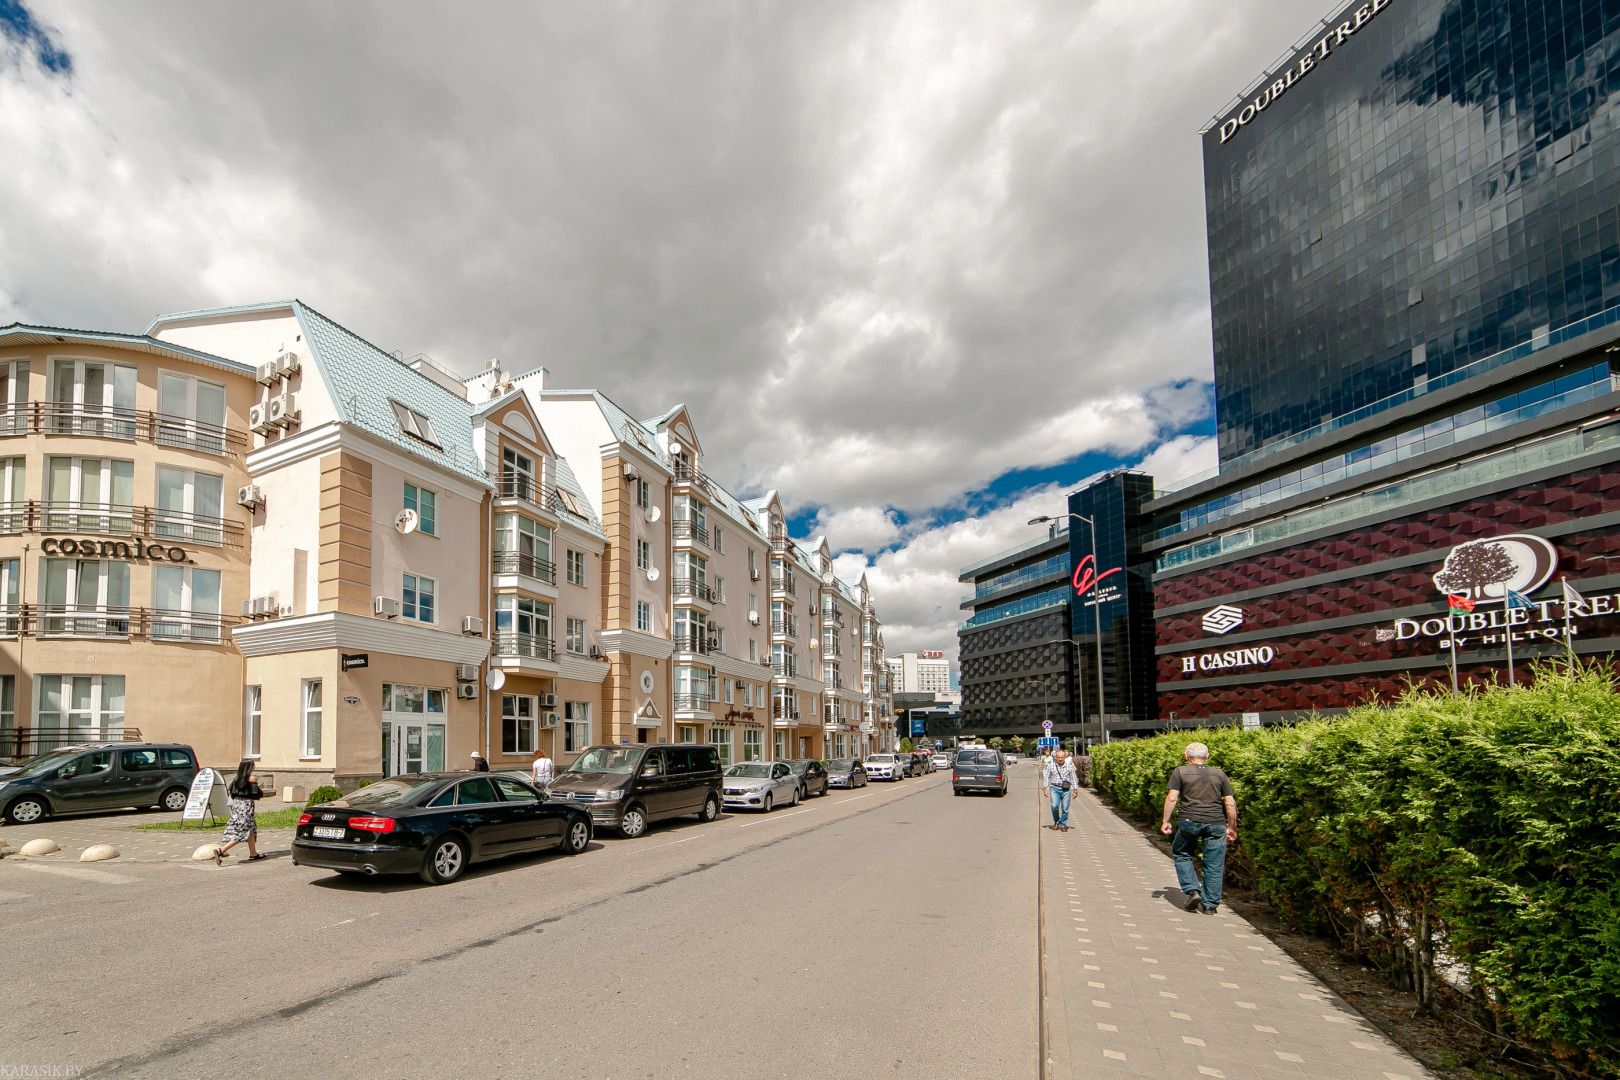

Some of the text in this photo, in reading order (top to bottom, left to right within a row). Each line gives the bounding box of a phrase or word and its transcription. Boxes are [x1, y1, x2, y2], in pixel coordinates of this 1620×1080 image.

[41, 537, 194, 563] cosmico.
[1086, 586, 1117, 597] GALERIA
[1395, 593, 1620, 641] DOUBLETRE
[1439, 625, 1578, 649] BY HILTON
[1182, 646, 1274, 672] H CASINO
